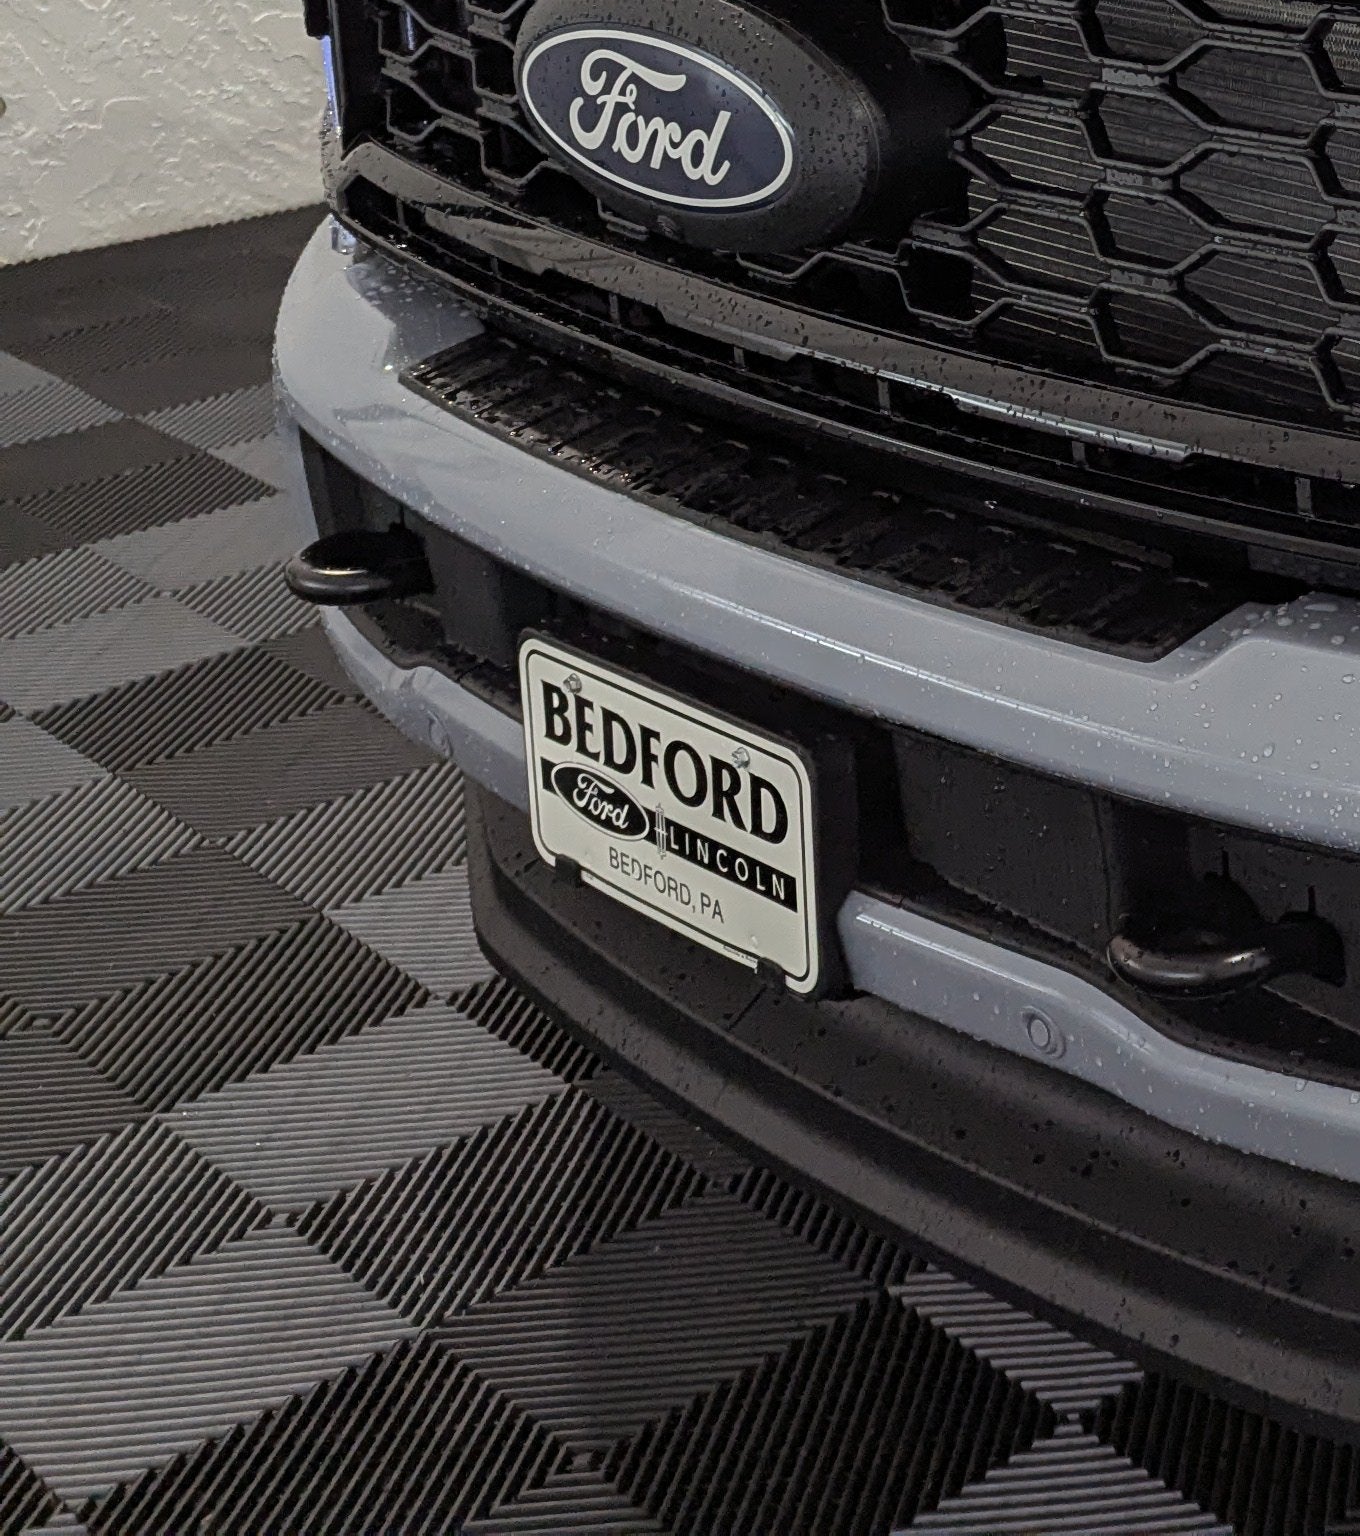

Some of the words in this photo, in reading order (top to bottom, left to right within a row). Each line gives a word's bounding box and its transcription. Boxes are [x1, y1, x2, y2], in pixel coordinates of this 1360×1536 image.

[569, 48, 732, 186] Ford
[541, 679, 789, 845] BEDFORD
[573, 772, 629, 830] Ford
[669, 828, 787, 902] LINCOLN
[608, 846, 697, 914] BEDFORD,
[699, 890, 725, 925] PA
